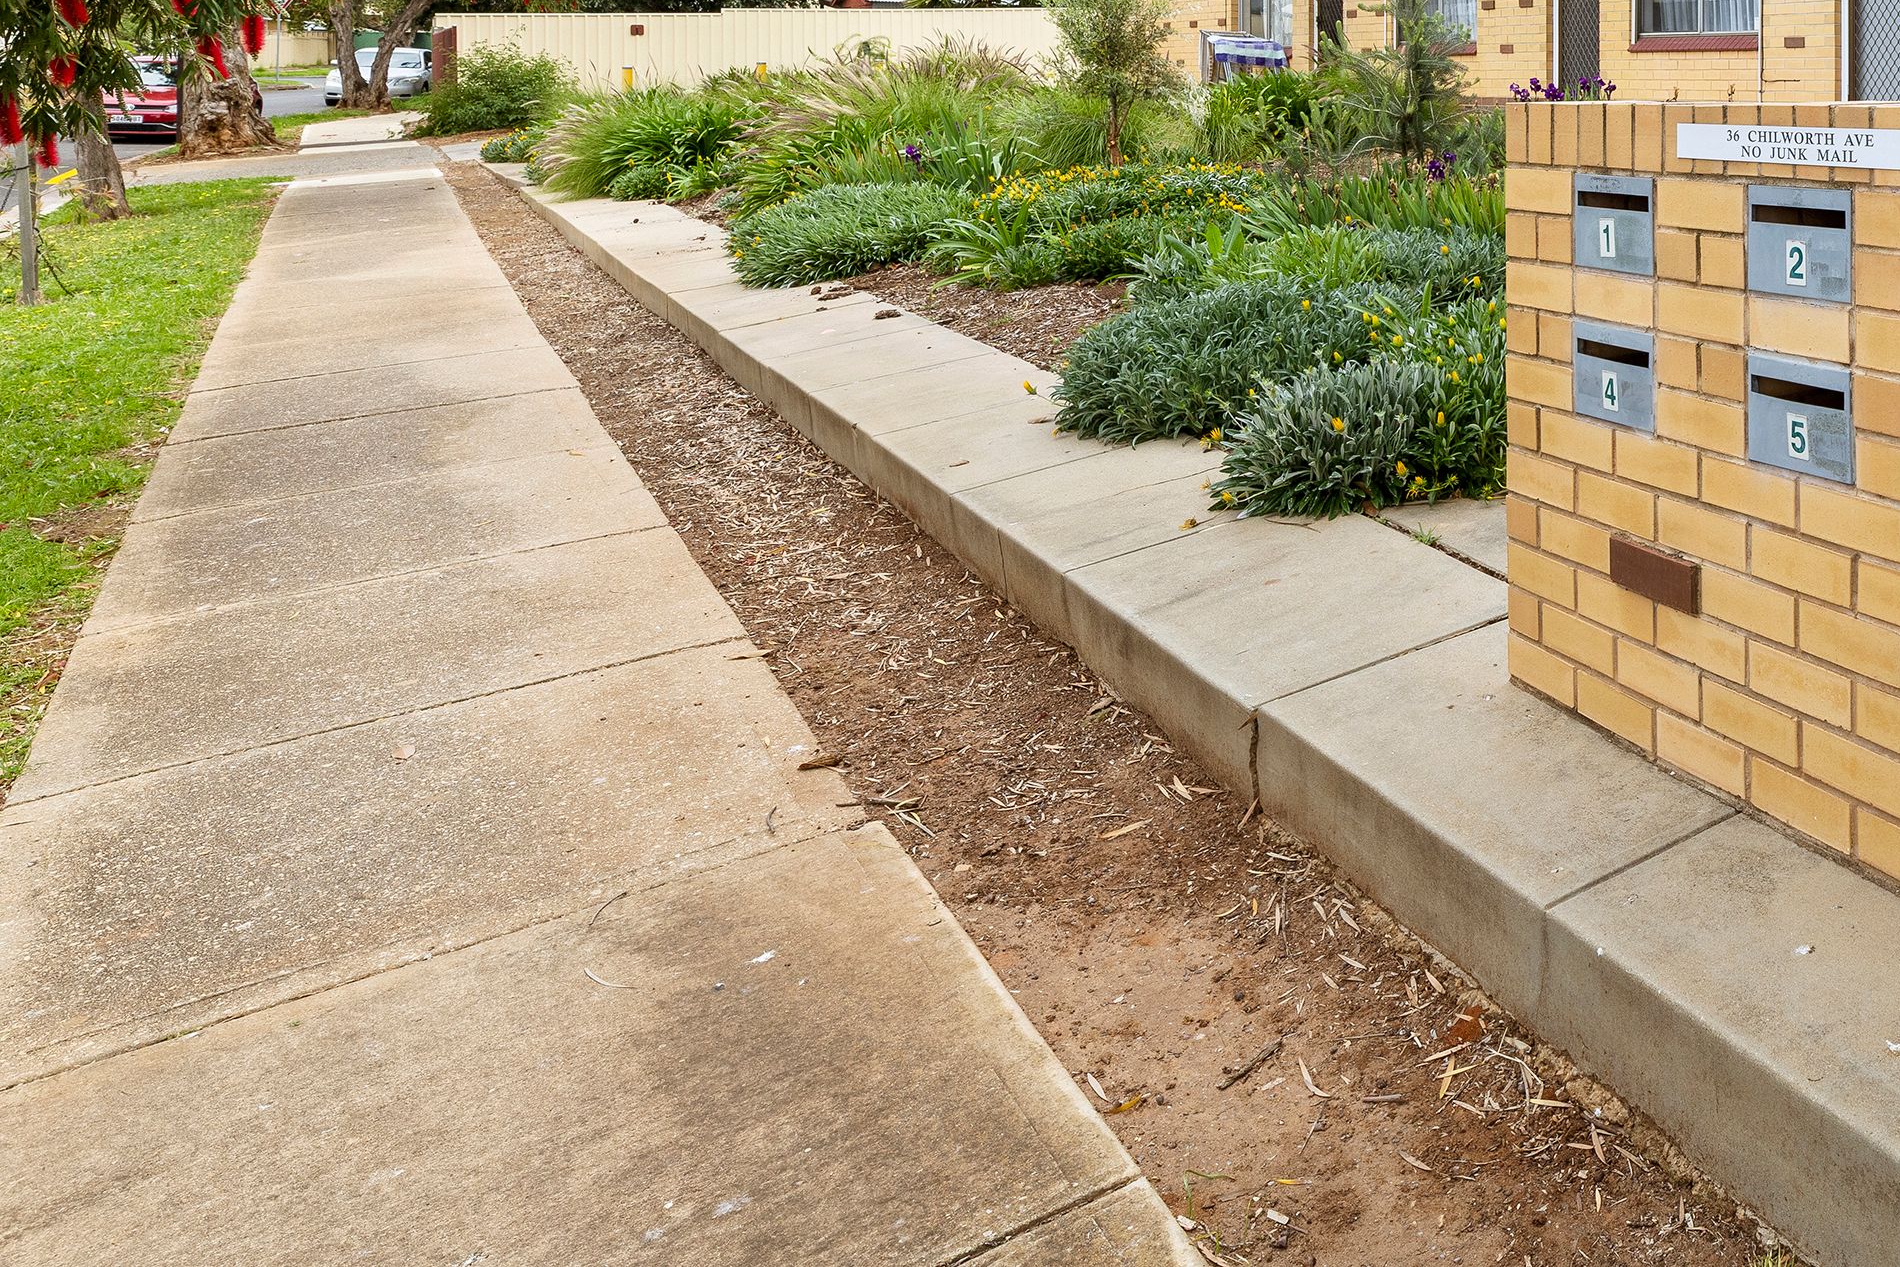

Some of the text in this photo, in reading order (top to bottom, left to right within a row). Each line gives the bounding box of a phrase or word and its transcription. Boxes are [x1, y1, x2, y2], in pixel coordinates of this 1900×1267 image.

[1726, 129, 1875, 148] 36 CHILWORTH AVE
[1741, 145, 1858, 163] NO JUNK MAIL
[1602, 224, 1610, 253] 1
[1789, 246, 1804, 280] 2
[1604, 377, 1617, 407] 4
[1791, 419, 1806, 454] 5
